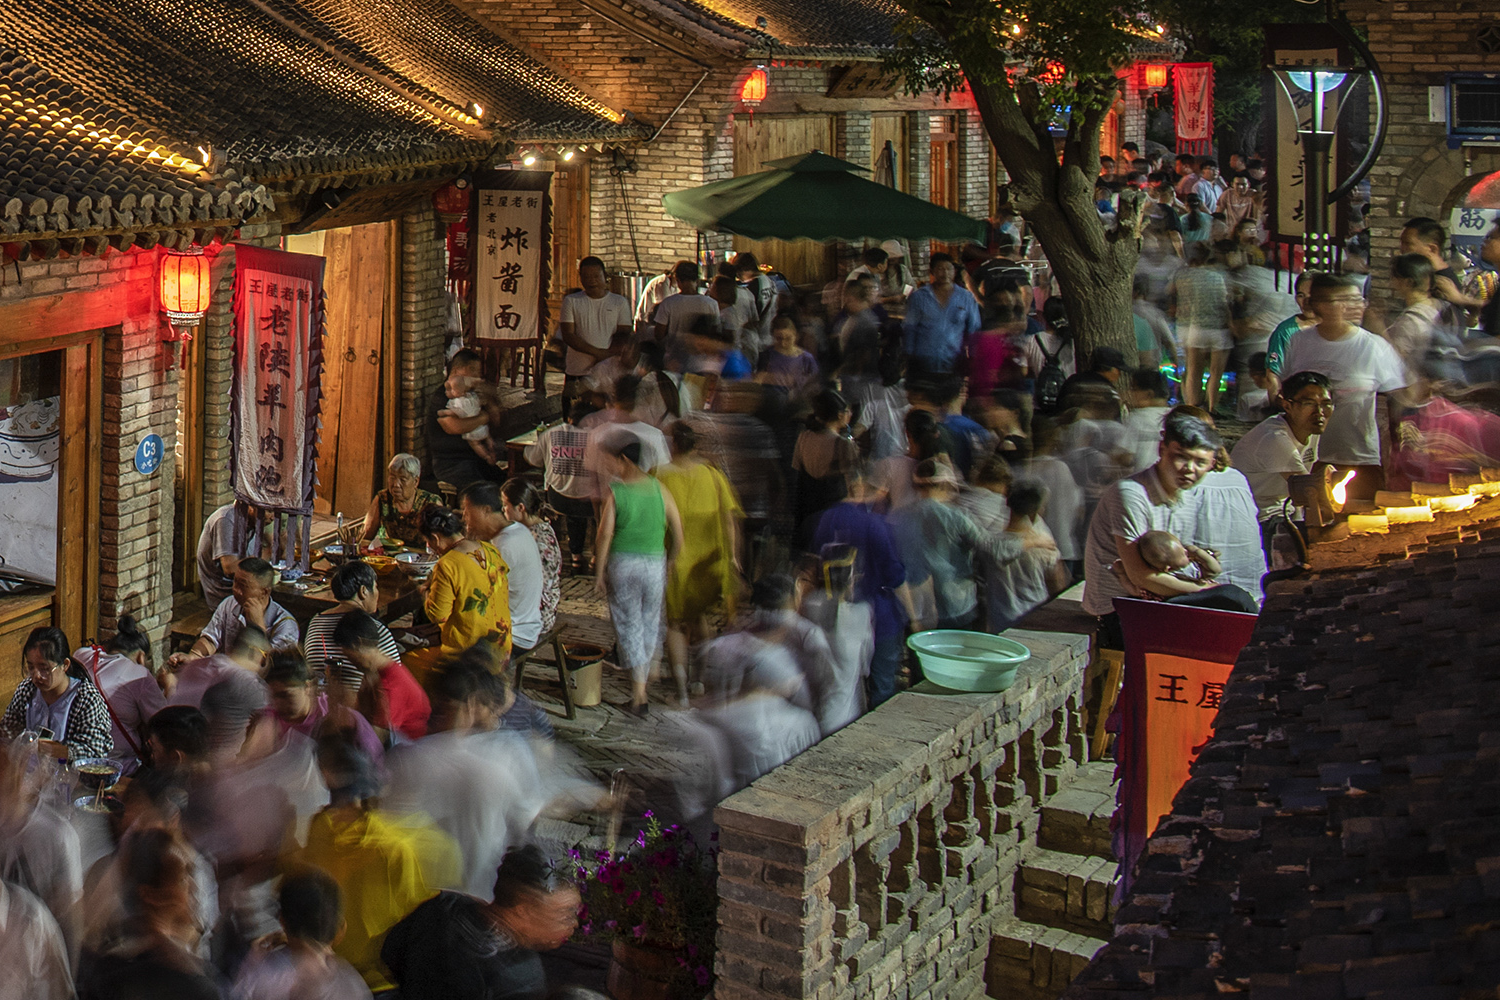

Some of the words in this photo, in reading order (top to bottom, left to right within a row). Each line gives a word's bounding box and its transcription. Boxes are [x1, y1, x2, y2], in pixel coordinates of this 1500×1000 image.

[1187, 82, 1200, 131] 羊肉串
[482, 194, 538, 209] 王屋老街
[485, 212, 497, 256] 老北京
[249, 278, 309, 304] 王屋老街
[492, 226, 529, 332] 炸酱面
[143, 440, 156, 458] C3
[1155, 673, 1226, 710] 王屋
